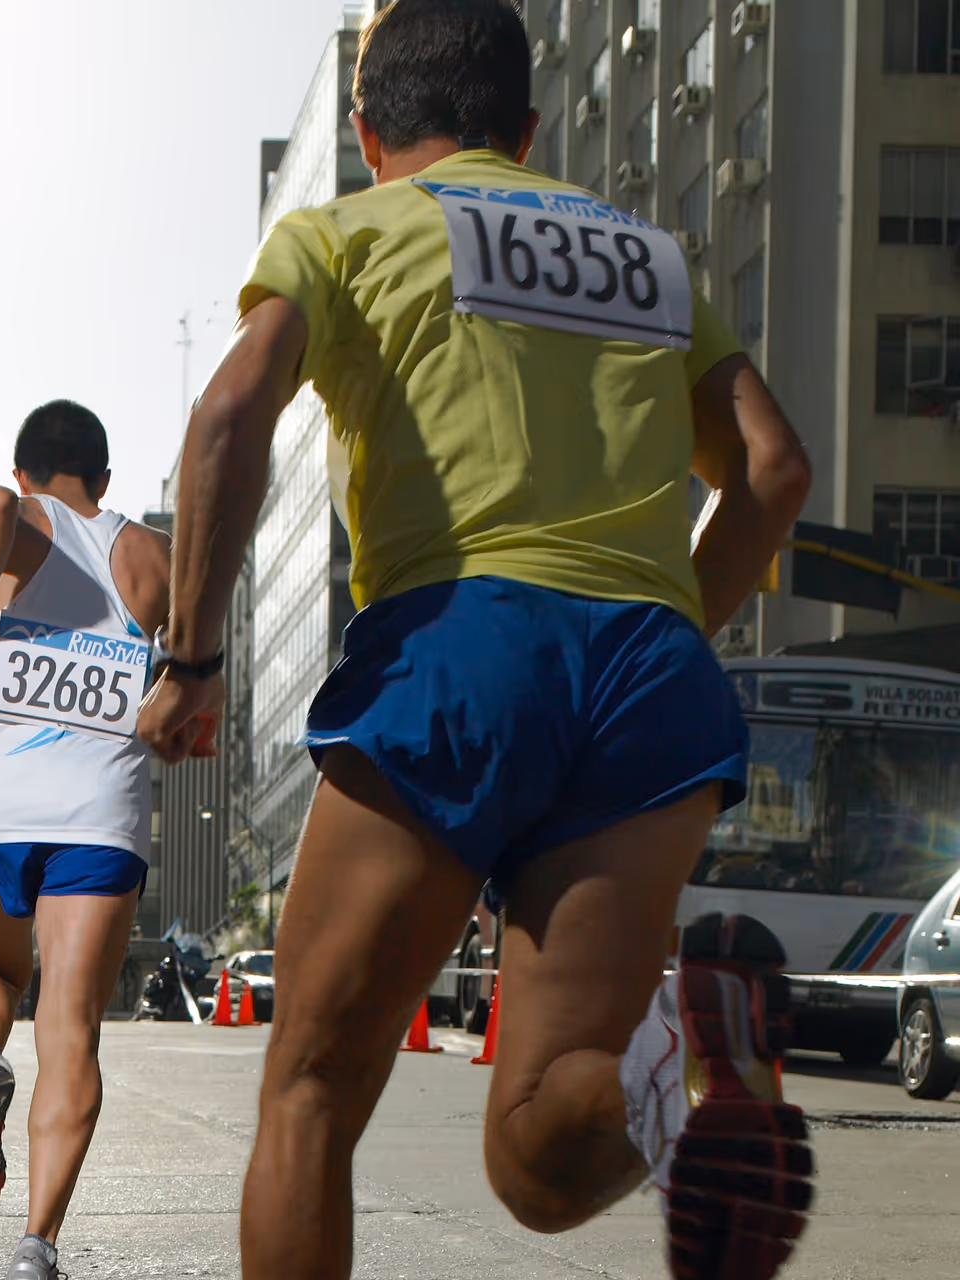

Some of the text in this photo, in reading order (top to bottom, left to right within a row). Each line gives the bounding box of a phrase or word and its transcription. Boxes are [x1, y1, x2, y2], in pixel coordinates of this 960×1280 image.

[461, 205, 659, 311] 16358
[67, 631, 148, 667] RunStyle
[2, 650, 132, 722] 32685
[864, 685, 903, 700] VILLA
[863, 700, 960, 719] RETIRO
